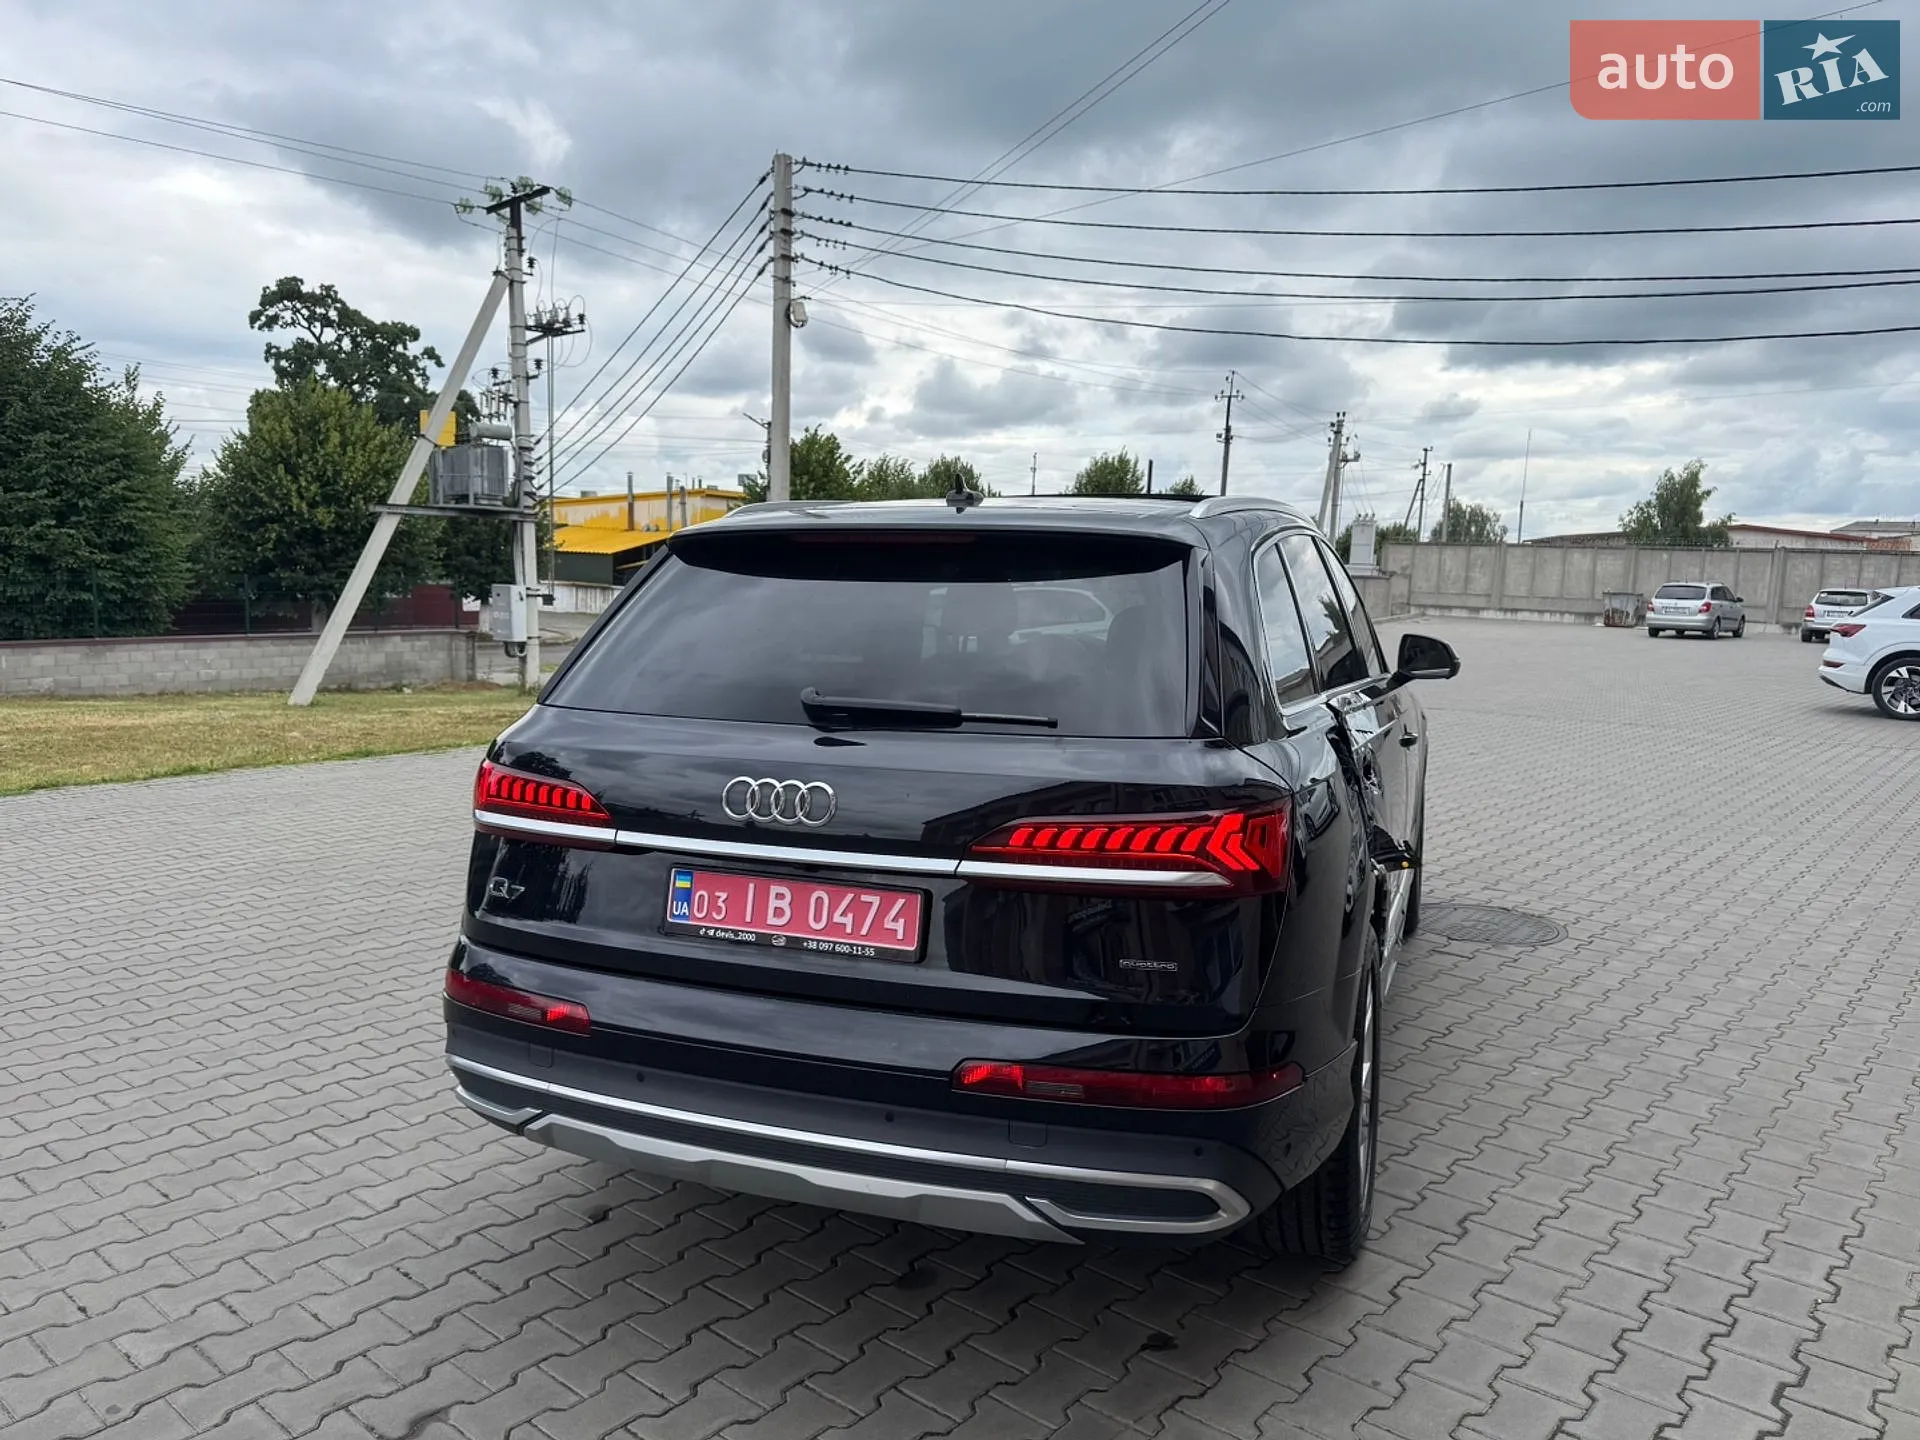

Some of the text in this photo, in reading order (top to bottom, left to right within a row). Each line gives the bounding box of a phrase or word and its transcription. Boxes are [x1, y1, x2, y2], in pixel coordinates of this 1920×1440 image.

[489, 876, 525, 900] Q7
[673, 900, 689, 916] UA
[693, 890, 728, 920] 03
[807, 890, 907, 940] 0474
[819, 942, 833, 951] 097
